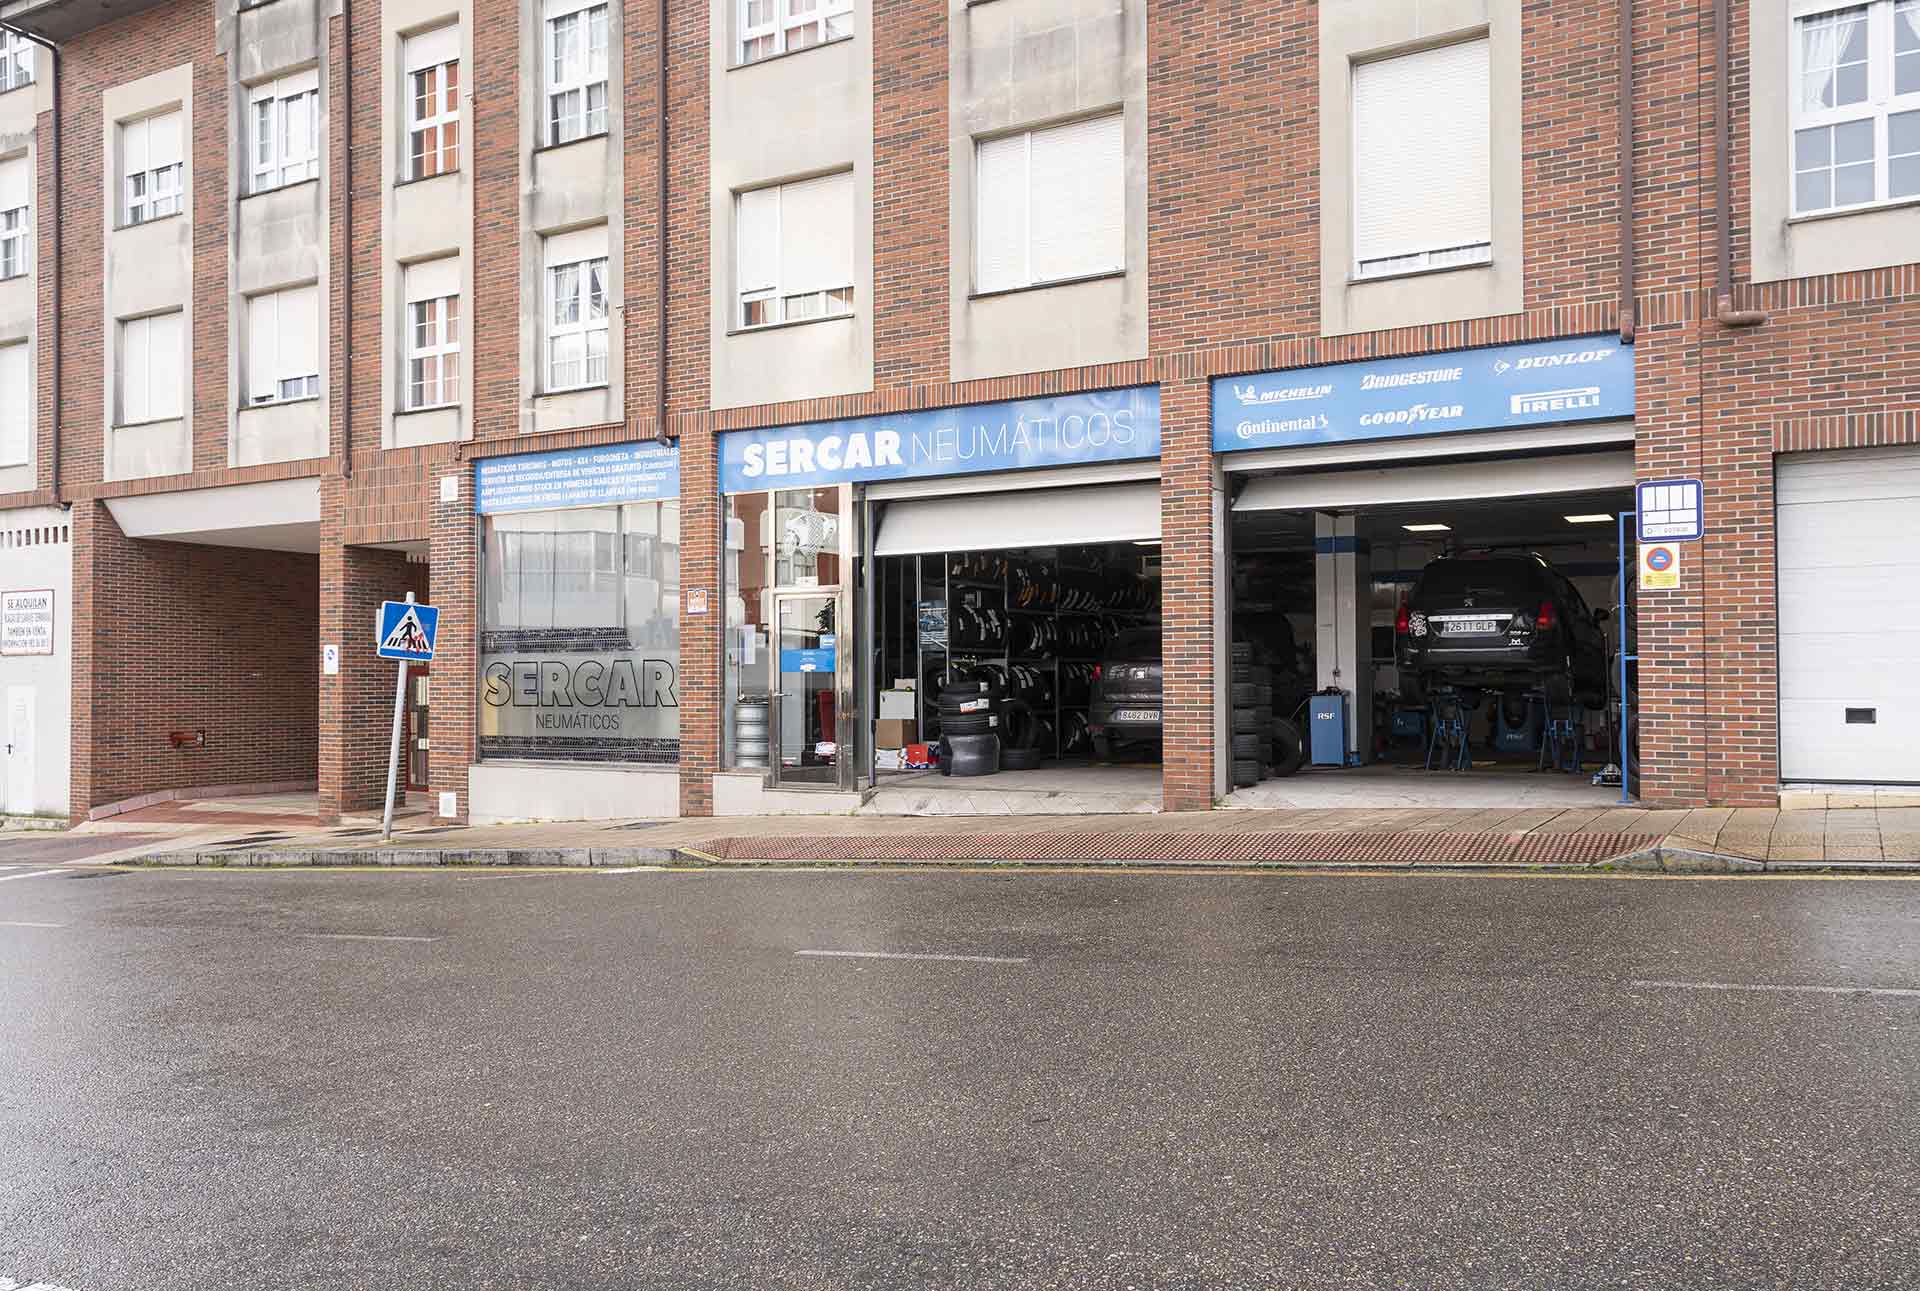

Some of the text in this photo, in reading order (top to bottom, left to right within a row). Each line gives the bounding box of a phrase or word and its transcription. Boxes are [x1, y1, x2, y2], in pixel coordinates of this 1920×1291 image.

[1517, 349, 1616, 369] DUNLOP
[1360, 367, 1463, 390] BRIDGESTONE
[1260, 385, 1332, 401] MICHELIN
[1510, 386, 1601, 414] PIRELLI
[1360, 403, 1463, 426] GOODYEAR
[1236, 415, 1316, 439] Continental
[742, 409, 1136, 477] SERCAR NEUMÁTICOS
[8, 597, 48, 609] SE ALQUILAN
[1450, 621, 1495, 632] 2611 GLP
[484, 659, 679, 707] SERCAR
[536, 711, 620, 730] NEUMÁTICOS
[1143, 711, 1158, 719] DVR
[1317, 712, 1336, 720] RSF
